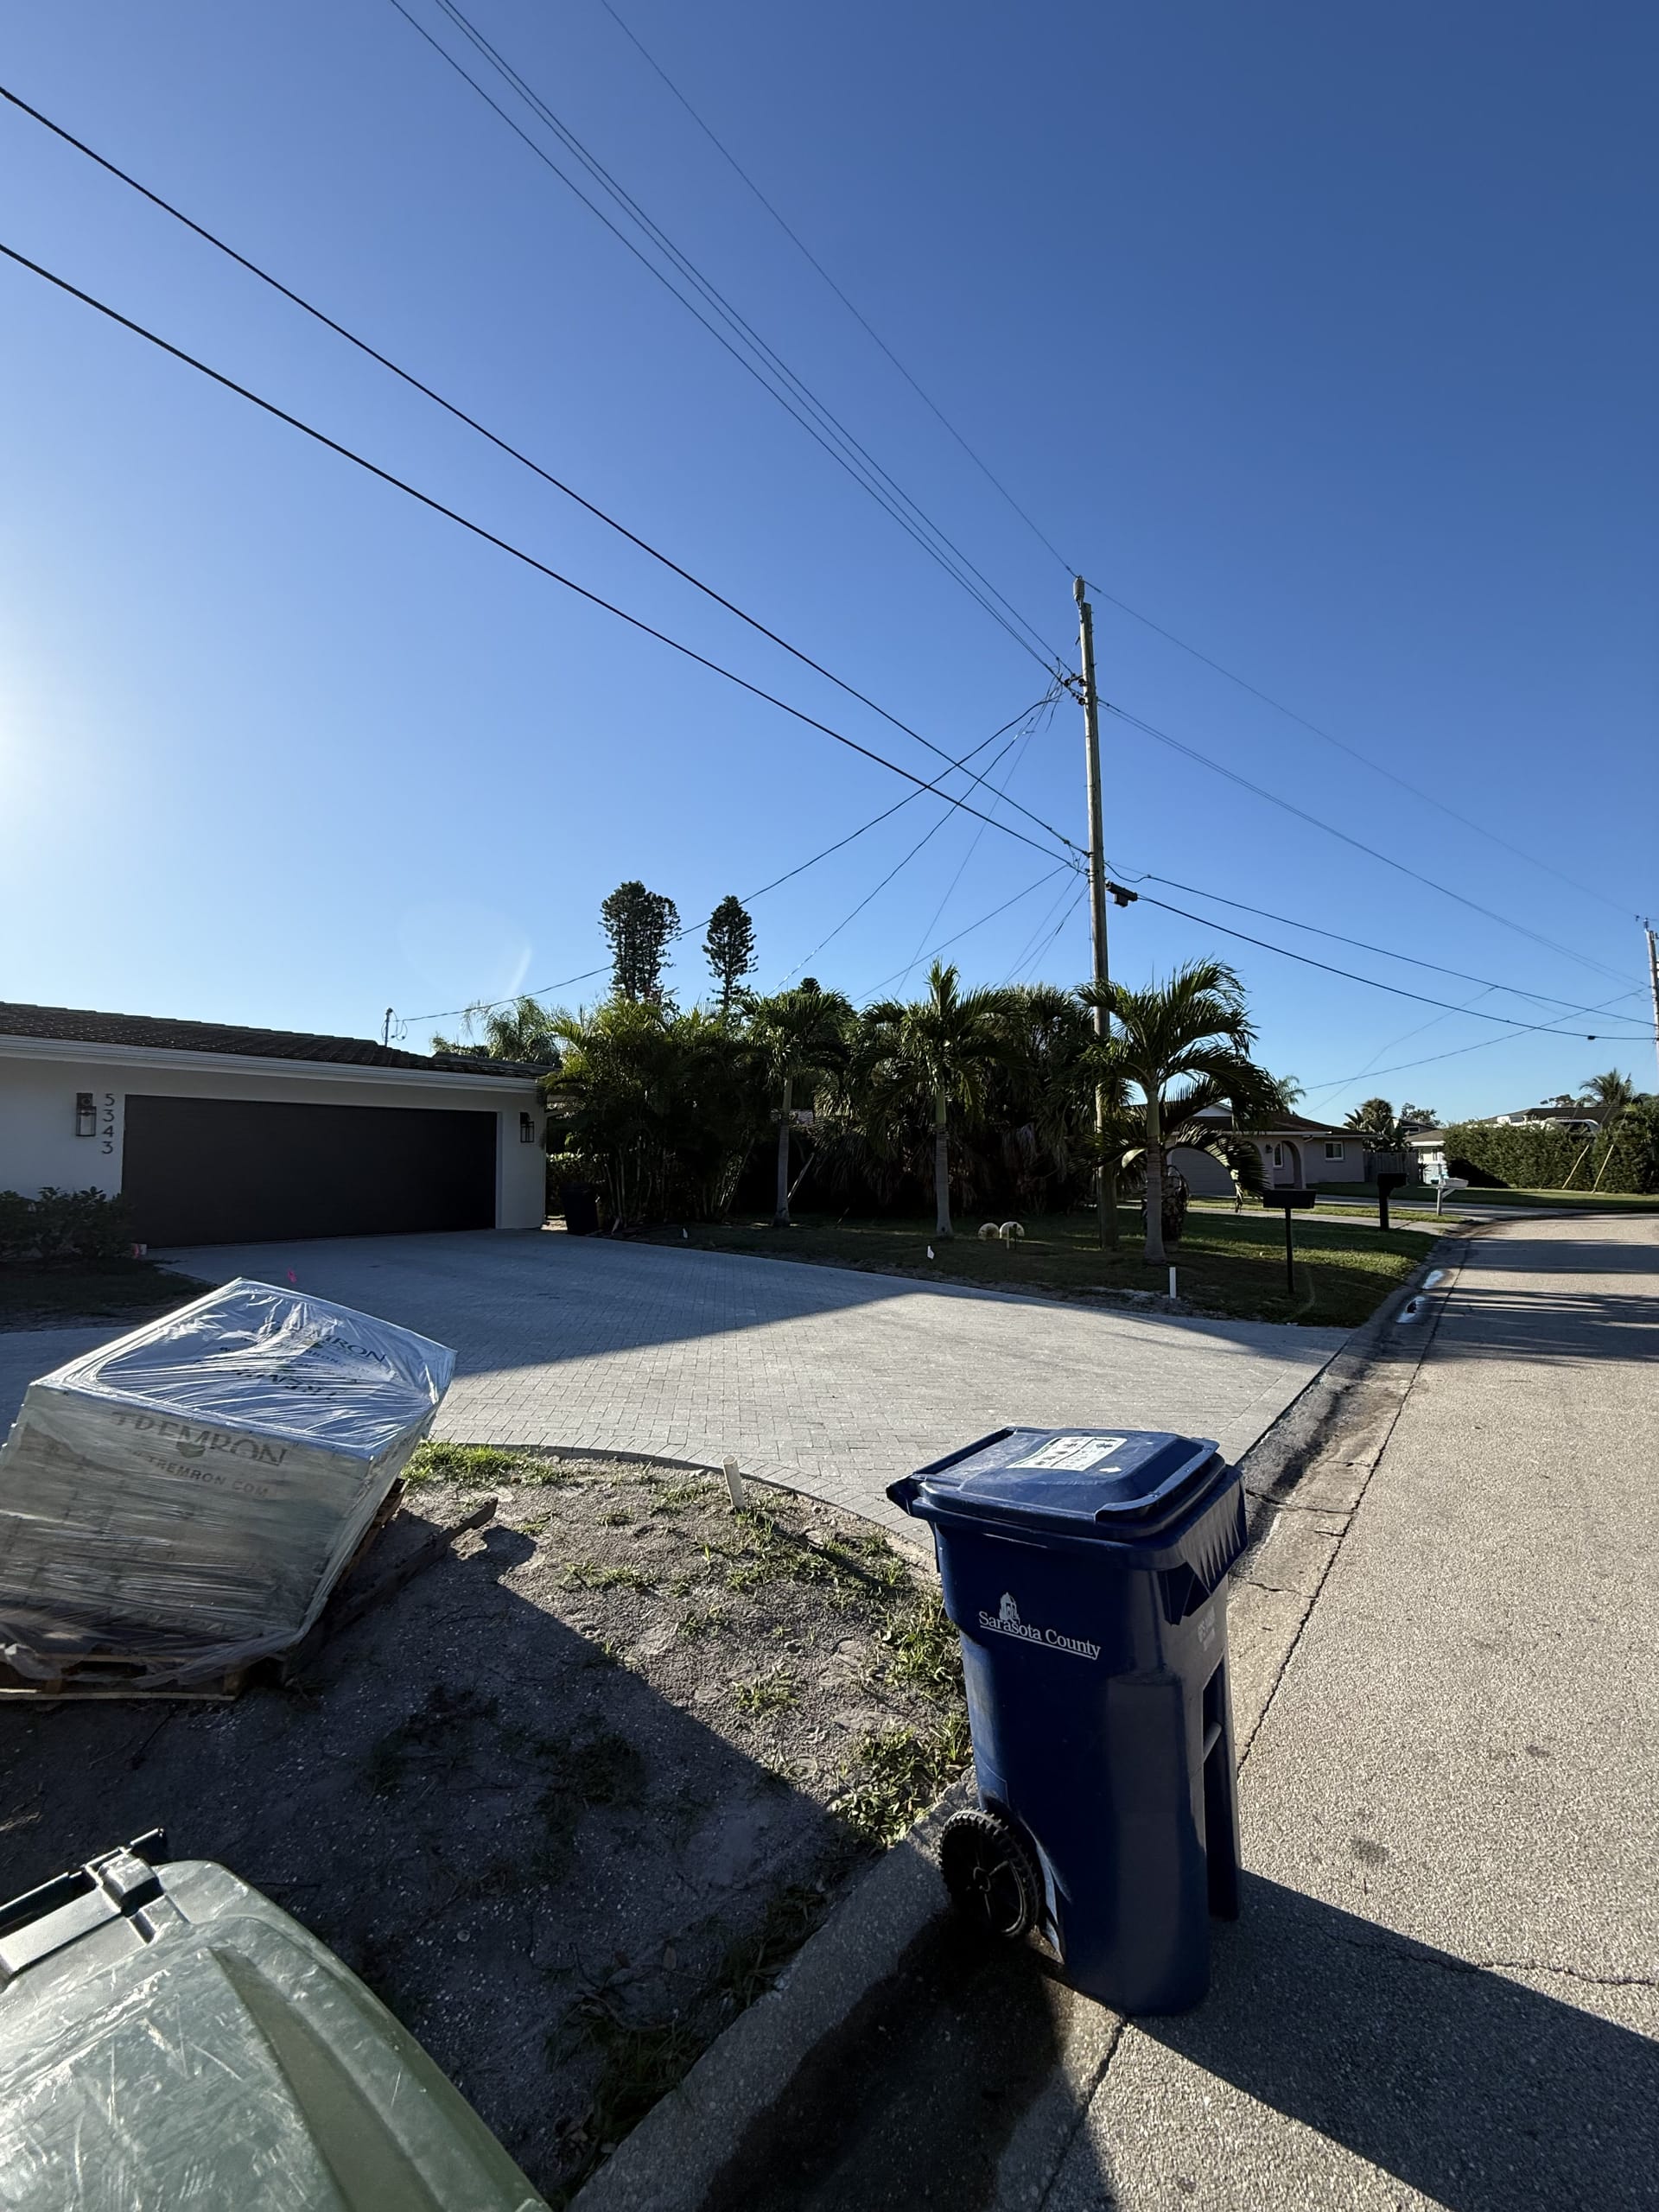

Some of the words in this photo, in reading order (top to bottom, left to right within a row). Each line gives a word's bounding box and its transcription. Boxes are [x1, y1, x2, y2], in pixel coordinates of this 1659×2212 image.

[101, 1093, 115, 1154] 5343
[979, 1611, 1042, 1641] Sarasota
[1045, 1629, 1101, 1661] County
